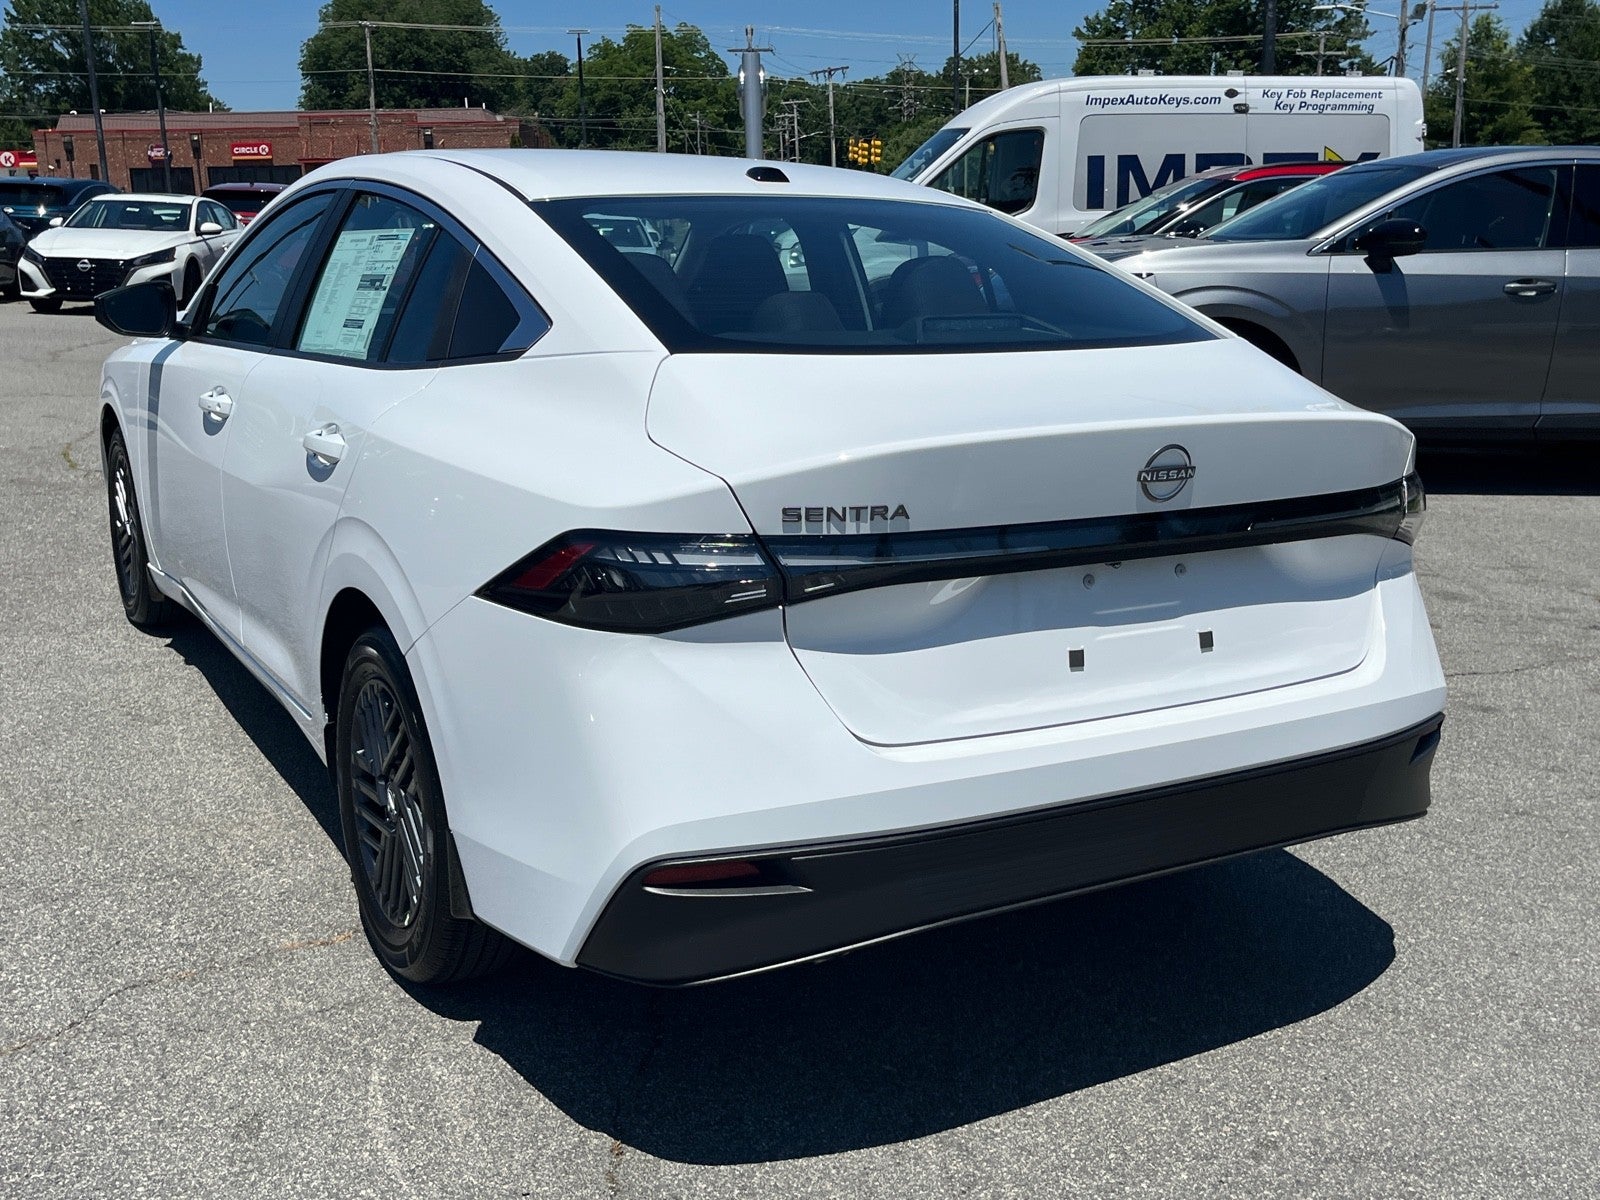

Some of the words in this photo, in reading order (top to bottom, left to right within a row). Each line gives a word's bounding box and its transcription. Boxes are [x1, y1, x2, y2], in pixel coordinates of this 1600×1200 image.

[1085, 93, 1222, 109] ImpexAutoKeys.com
[1262, 89, 1283, 101] Key
[1286, 89, 1307, 99] Fob
[1310, 88, 1383, 101] Replacement
[1274, 101, 1295, 114] Key
[1298, 101, 1375, 114] Programming
[260, 145, 269, 155] K
[1140, 468, 1195, 481] NISSAN
[782, 504, 910, 522] SENTRA
